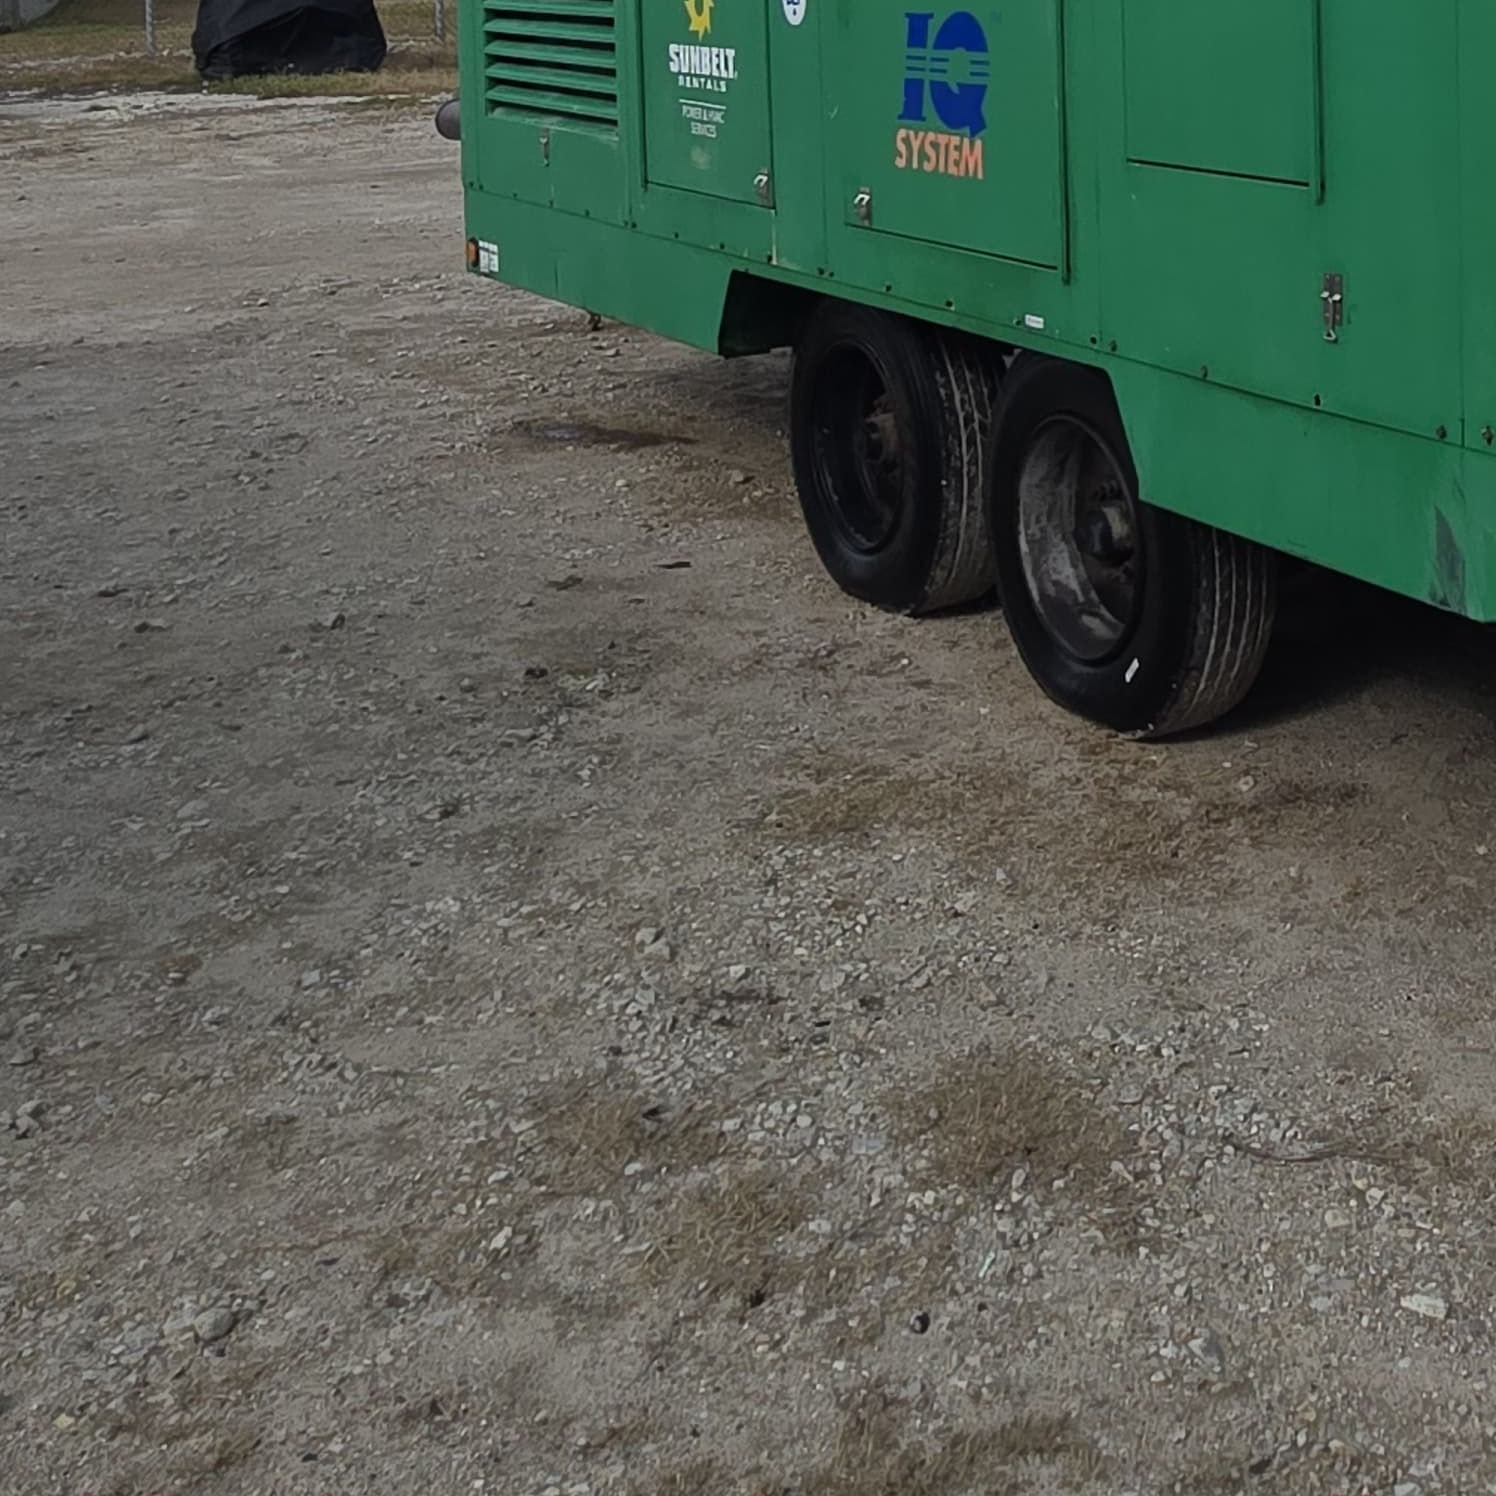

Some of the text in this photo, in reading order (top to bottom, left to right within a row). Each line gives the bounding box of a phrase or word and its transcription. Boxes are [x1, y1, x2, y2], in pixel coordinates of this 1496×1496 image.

[668, 43, 736, 79] SUNBELT
[897, 11, 991, 138] IQ
[894, 128, 985, 180] SYSTEM
